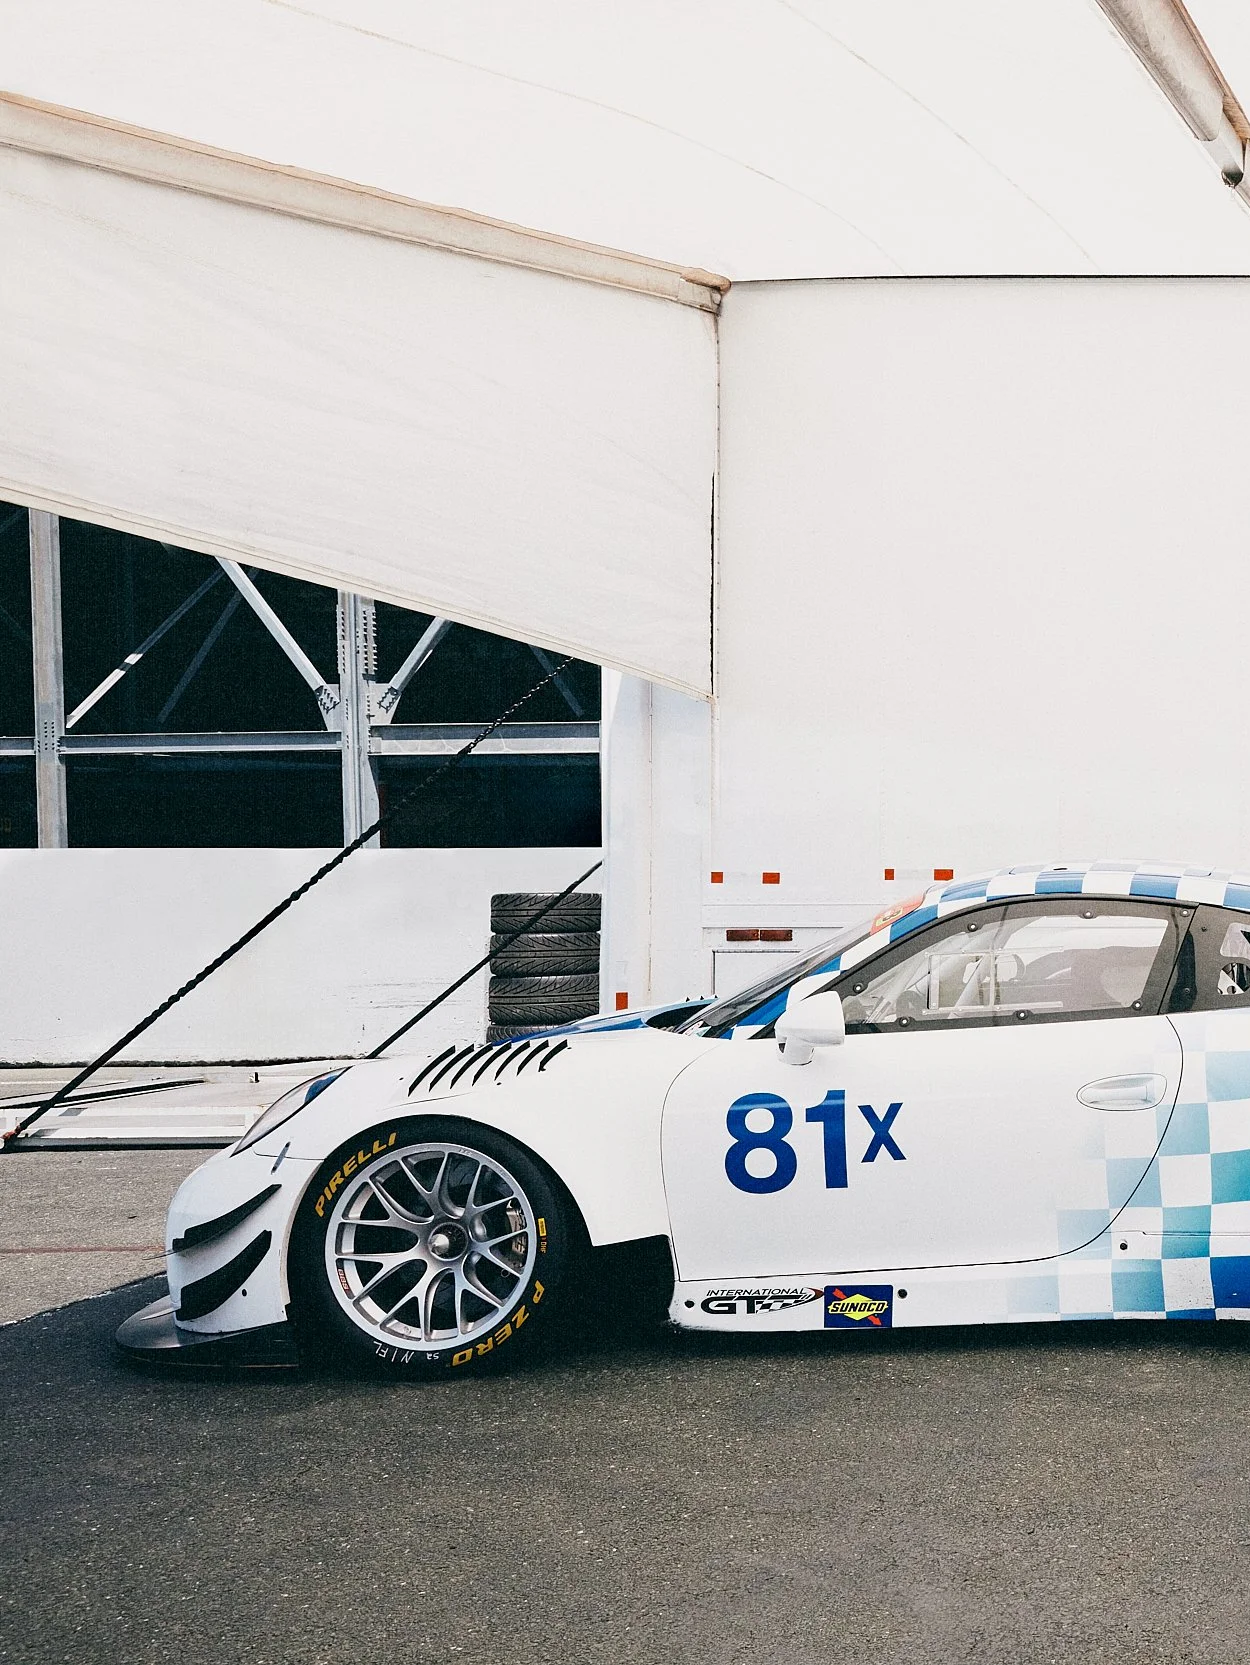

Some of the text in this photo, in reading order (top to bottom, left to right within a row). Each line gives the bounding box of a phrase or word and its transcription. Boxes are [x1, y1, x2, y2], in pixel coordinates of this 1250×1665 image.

[314, 1132, 397, 1218] PIRELLI
[706, 1288, 807, 1297] INTERNATIONAL
[701, 1295, 768, 1315] GT
[831, 1302, 886, 1313] SUNOCO
